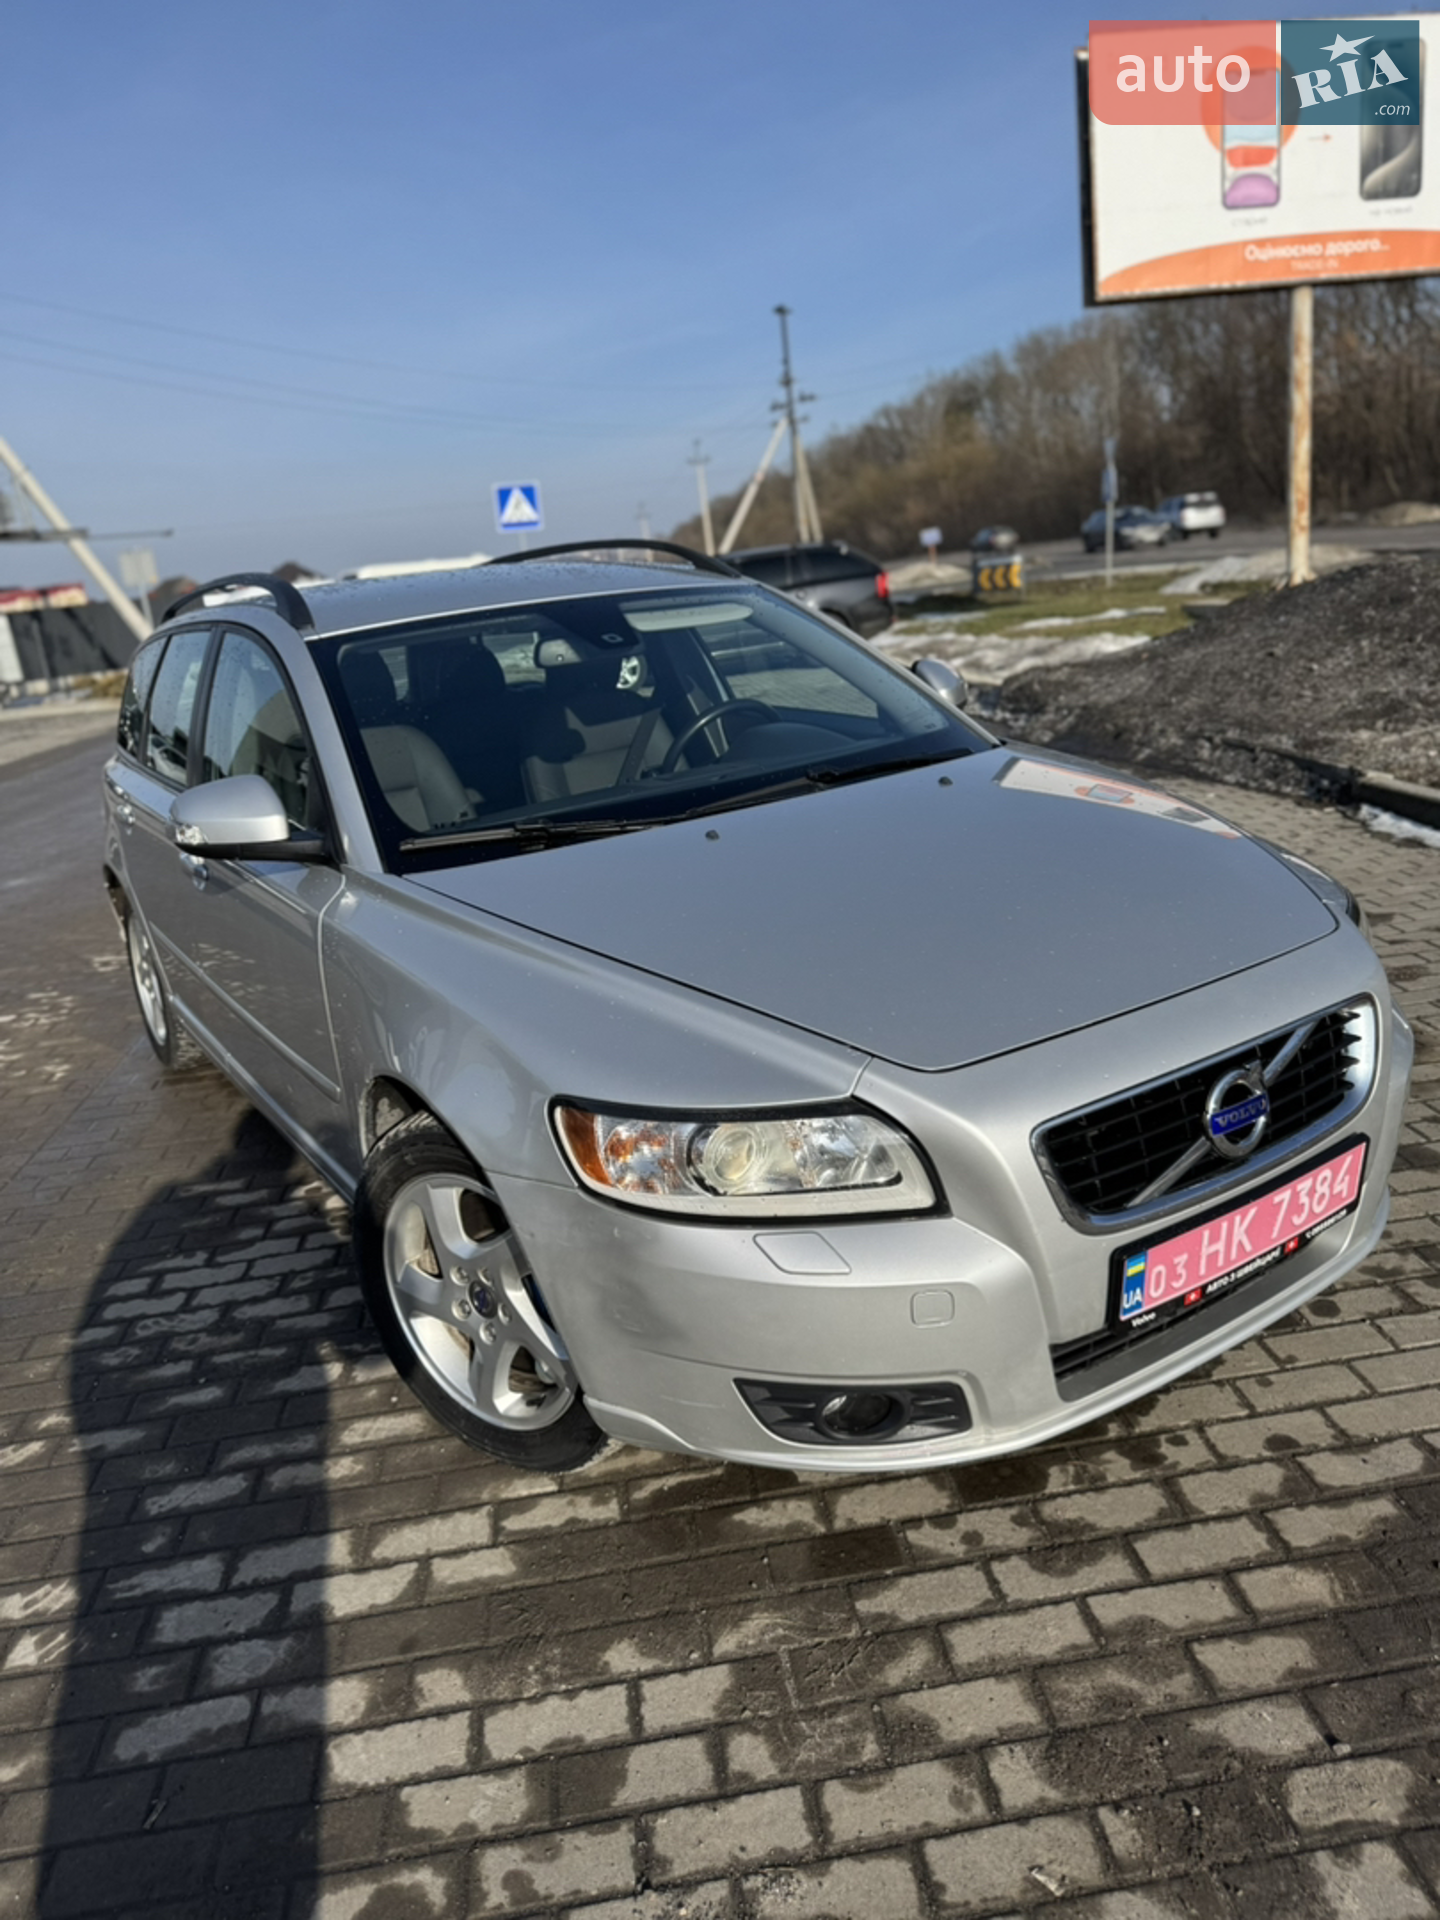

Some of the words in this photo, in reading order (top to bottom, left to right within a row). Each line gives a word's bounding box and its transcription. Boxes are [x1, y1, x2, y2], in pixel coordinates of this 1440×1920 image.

[1214, 1098, 1267, 1127] VOLVO
[1149, 1253, 1189, 1299] 03
[1271, 1155, 1353, 1240] 7384
[1123, 1287, 1143, 1309] UA
